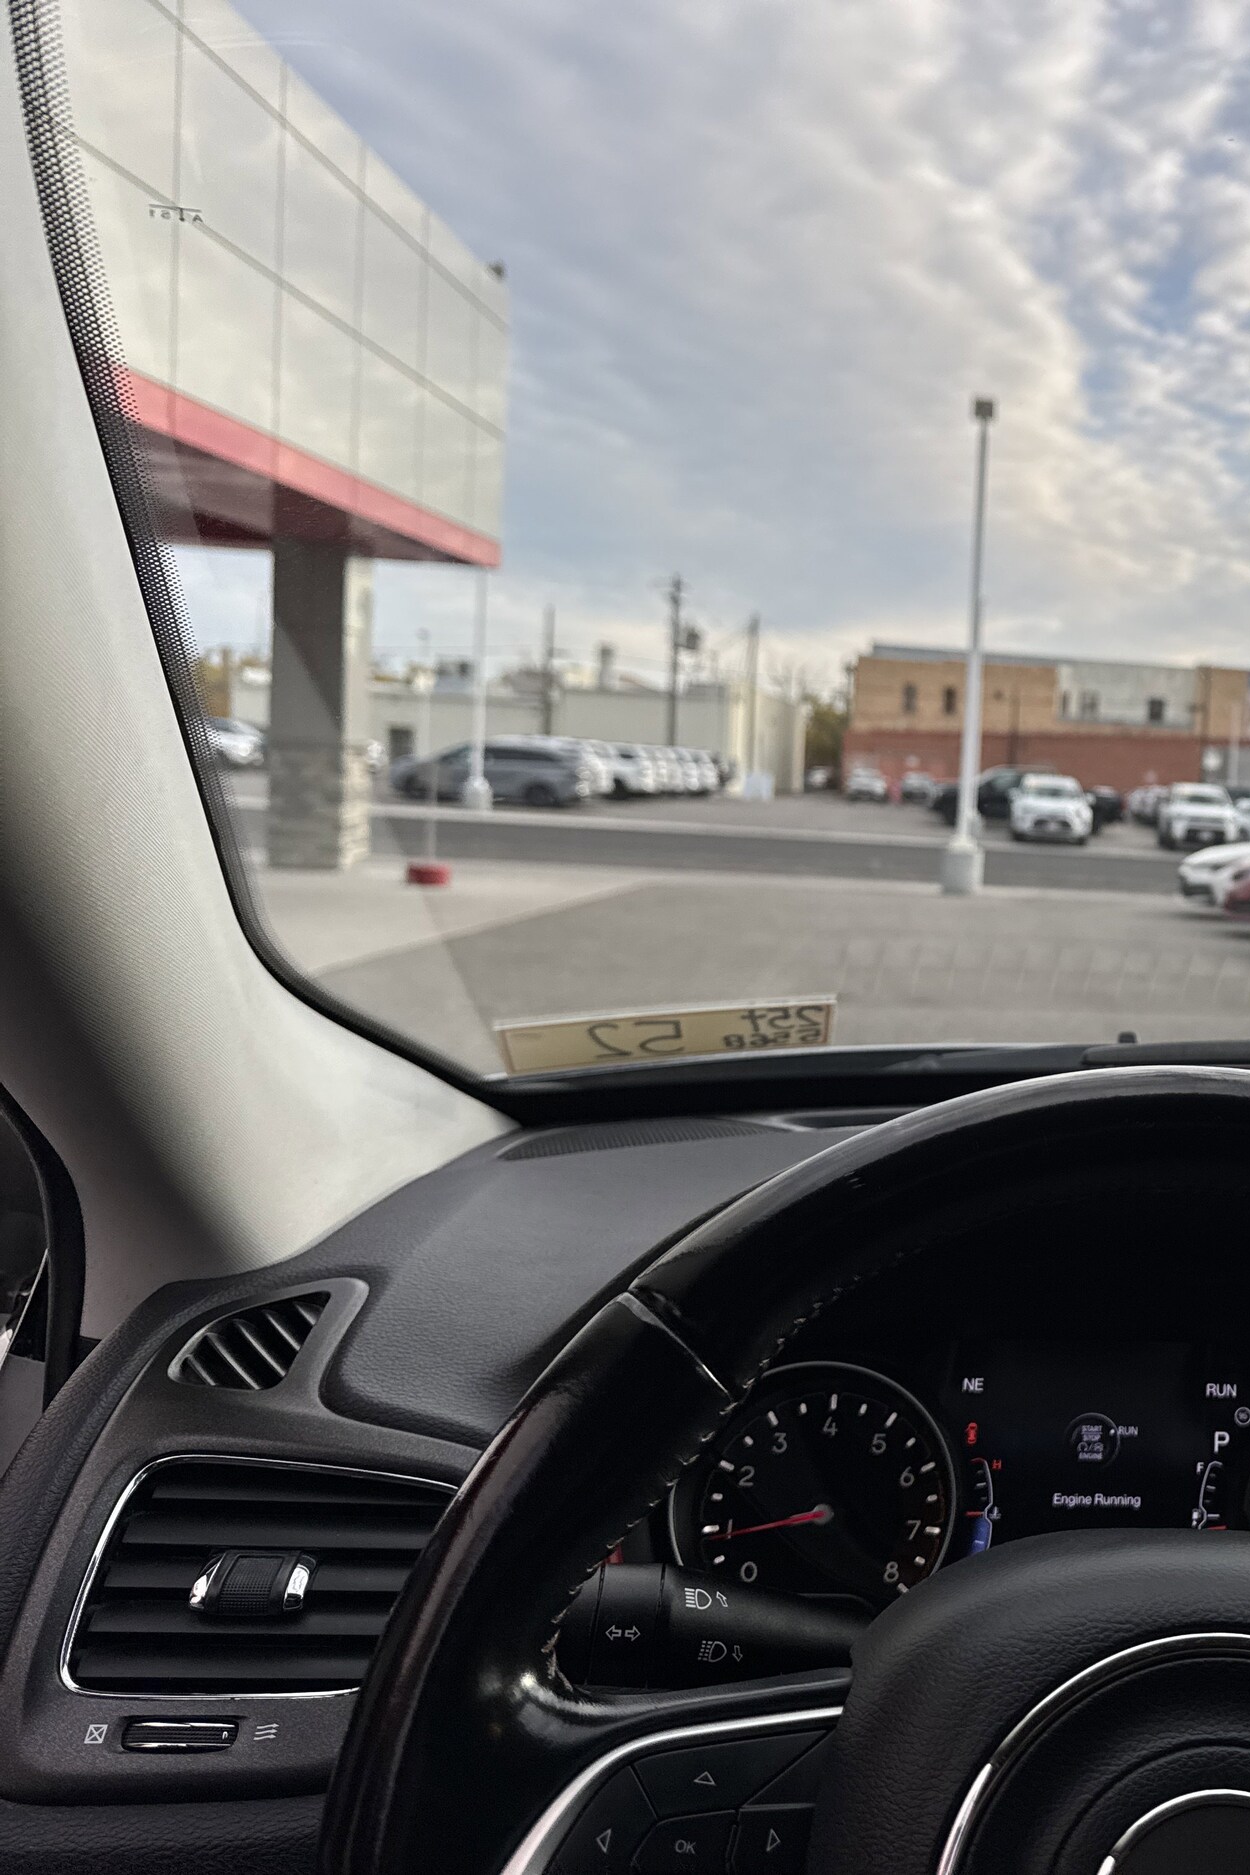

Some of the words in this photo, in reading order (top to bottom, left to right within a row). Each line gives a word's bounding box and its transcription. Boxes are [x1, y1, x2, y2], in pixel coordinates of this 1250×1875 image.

[962, 1377, 984, 1392] NE
[1205, 1382, 1237, 1397] RUN
[822, 1416, 838, 1436] 4
[1117, 1425, 1139, 1438] RUN
[771, 1432, 788, 1454] 3
[871, 1433, 887, 1455] 5
[1213, 1431, 1230, 1453] P
[991, 1459, 1002, 1470] H
[1195, 1461, 1205, 1475] F
[738, 1465, 755, 1487] 2
[899, 1466, 915, 1488] 6
[1052, 1492, 1093, 1508] Engine
[1093, 1493, 1142, 1509] Running
[907, 1519, 922, 1541] 7
[740, 1561, 758, 1583] 0
[883, 1561, 899, 1584] 8
[675, 1839, 696, 1854] OK
